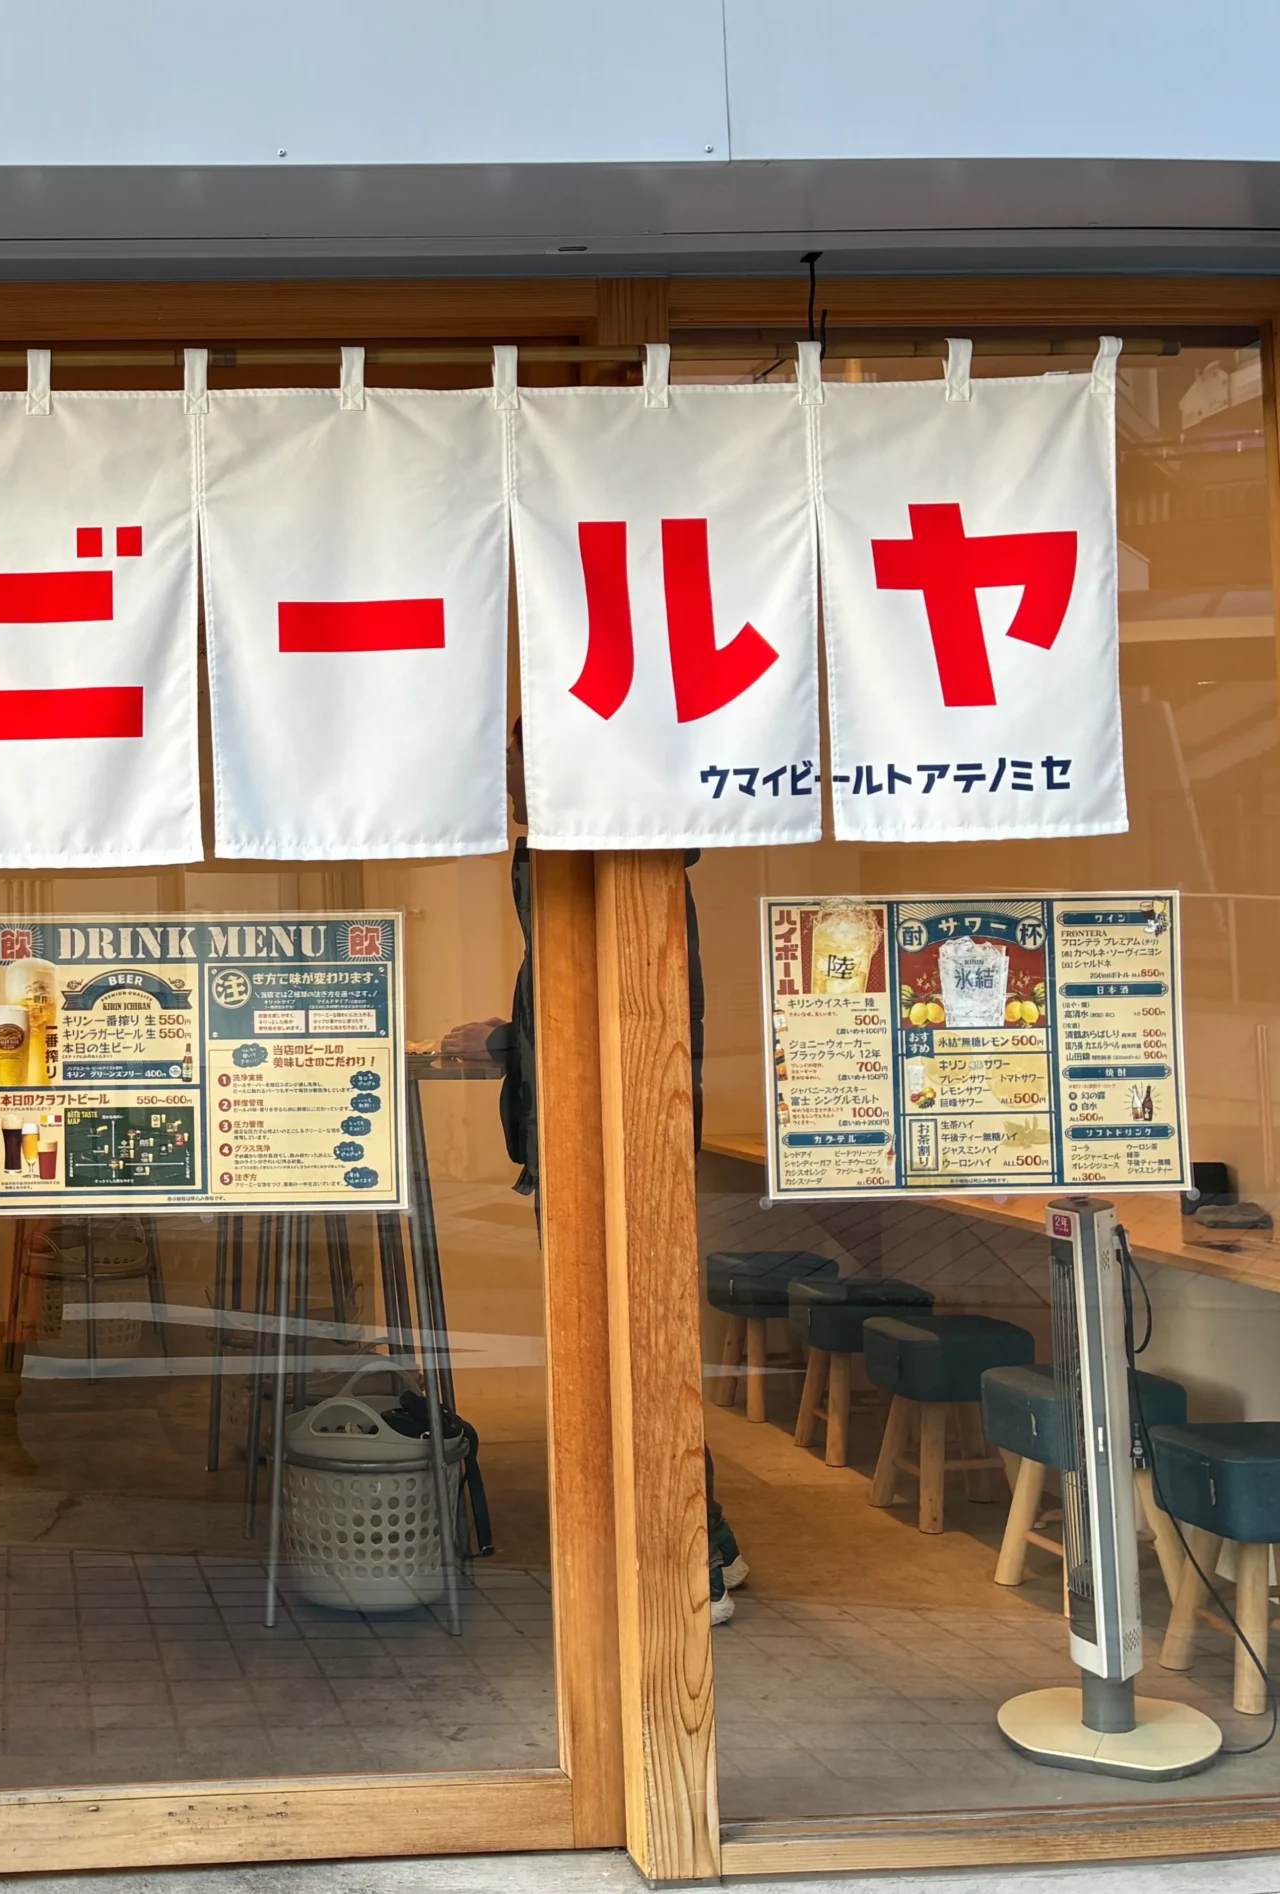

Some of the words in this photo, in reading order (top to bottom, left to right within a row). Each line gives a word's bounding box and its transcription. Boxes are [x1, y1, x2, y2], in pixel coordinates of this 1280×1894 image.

[699, 755, 1073, 799] ウマイビールトアテノミセ
[1094, 914, 1126, 923] ワイン
[938, 917, 1008, 936] サワー
[1020, 923, 1042, 946] 杯
[0, 929, 32, 960] 飲
[58, 927, 197, 960] DRINK
[208, 926, 327, 958] MENU
[349, 926, 382, 957] 飲
[1061, 938, 1101, 947] フロンテラ
[774, 909, 799, 996] ハイボール
[827, 953, 855, 980] 陸
[108, 974, 143, 987] BEER
[954, 968, 995, 990] 氷結
[217, 975, 249, 1005] 注
[252, 972, 380, 985] ぎ方で味が変わります。
[1096, 985, 1130, 995] 日本酒
[103, 1002, 122, 1011] KIRIN
[124, 1002, 151, 1011] ICHIBAN
[788, 998, 861, 1009] キリンウイスキー
[63, 1015, 140, 1027] キリン一番搾り
[144, 1015, 157, 1026] 生
[159, 1014, 191, 1026] 550円
[854, 1014, 887, 1026] 500円
[63, 1029, 144, 1040] キリンラガービール
[145, 1028, 157, 1039] 生
[159, 1028, 191, 1039] 550円
[909, 1032, 929, 1042] おす
[789, 1039, 872, 1050] ジョニーウォーカー
[1011, 1035, 1044, 1047] 500円
[1085, 1041, 1120, 1050] カエルラベル
[45, 1025, 58, 1079] 一番搾り
[62, 1042, 146, 1054] 本日の生ビール
[273, 1045, 344, 1056] 当店のビールの
[910, 1043, 930, 1053] すめ
[789, 1050, 855, 1061] ブラックラベル
[859, 1049, 881, 1059] 12年
[856, 1061, 888, 1073] 700円
[939, 1060, 967, 1070] キリン
[984, 1060, 1011, 1070] サワー
[1105, 1068, 1127, 1077] 焼酎
[1000, 1074, 1045, 1083] トマトサワー
[940, 1087, 991, 1096] レモンサワー
[0, 1094, 110, 1107] 本日のクラフトビール
[790, 1096, 811, 1106] 富士
[814, 1095, 880, 1106] シングルモルト
[940, 1099, 983, 1108] 巨峰サワー
[1081, 1102, 1098, 1111] 白水
[851, 1106, 889, 1118] 1000円
[234, 1120, 264, 1128] 圧力管理
[940, 1120, 974, 1130] 生茶ハイ
[941, 1132, 1018, 1142] 午後ティー無糖ハイ
[1086, 1128, 1152, 1137] ソフトドリンク
[234, 1144, 271, 1153] グラス洗浄
[917, 1123, 931, 1168] お茶割り
[942, 1145, 998, 1155] ジャスミンハイ
[1126, 1143, 1158, 1151] ウーロン茶
[784, 1151, 812, 1159] レッドアイ
[1071, 1153, 1121, 1161] ジンジャーエール
[784, 1160, 832, 1168] シャンディーガフ
[942, 1158, 992, 1167] ウーロンハイ
[1072, 1162, 1120, 1170] オレンジジュース
[235, 1173, 257, 1181] 注ぎ方
[785, 1169, 828, 1177] カシスオレンジ
[785, 1177, 823, 1185] カシスソーダ
